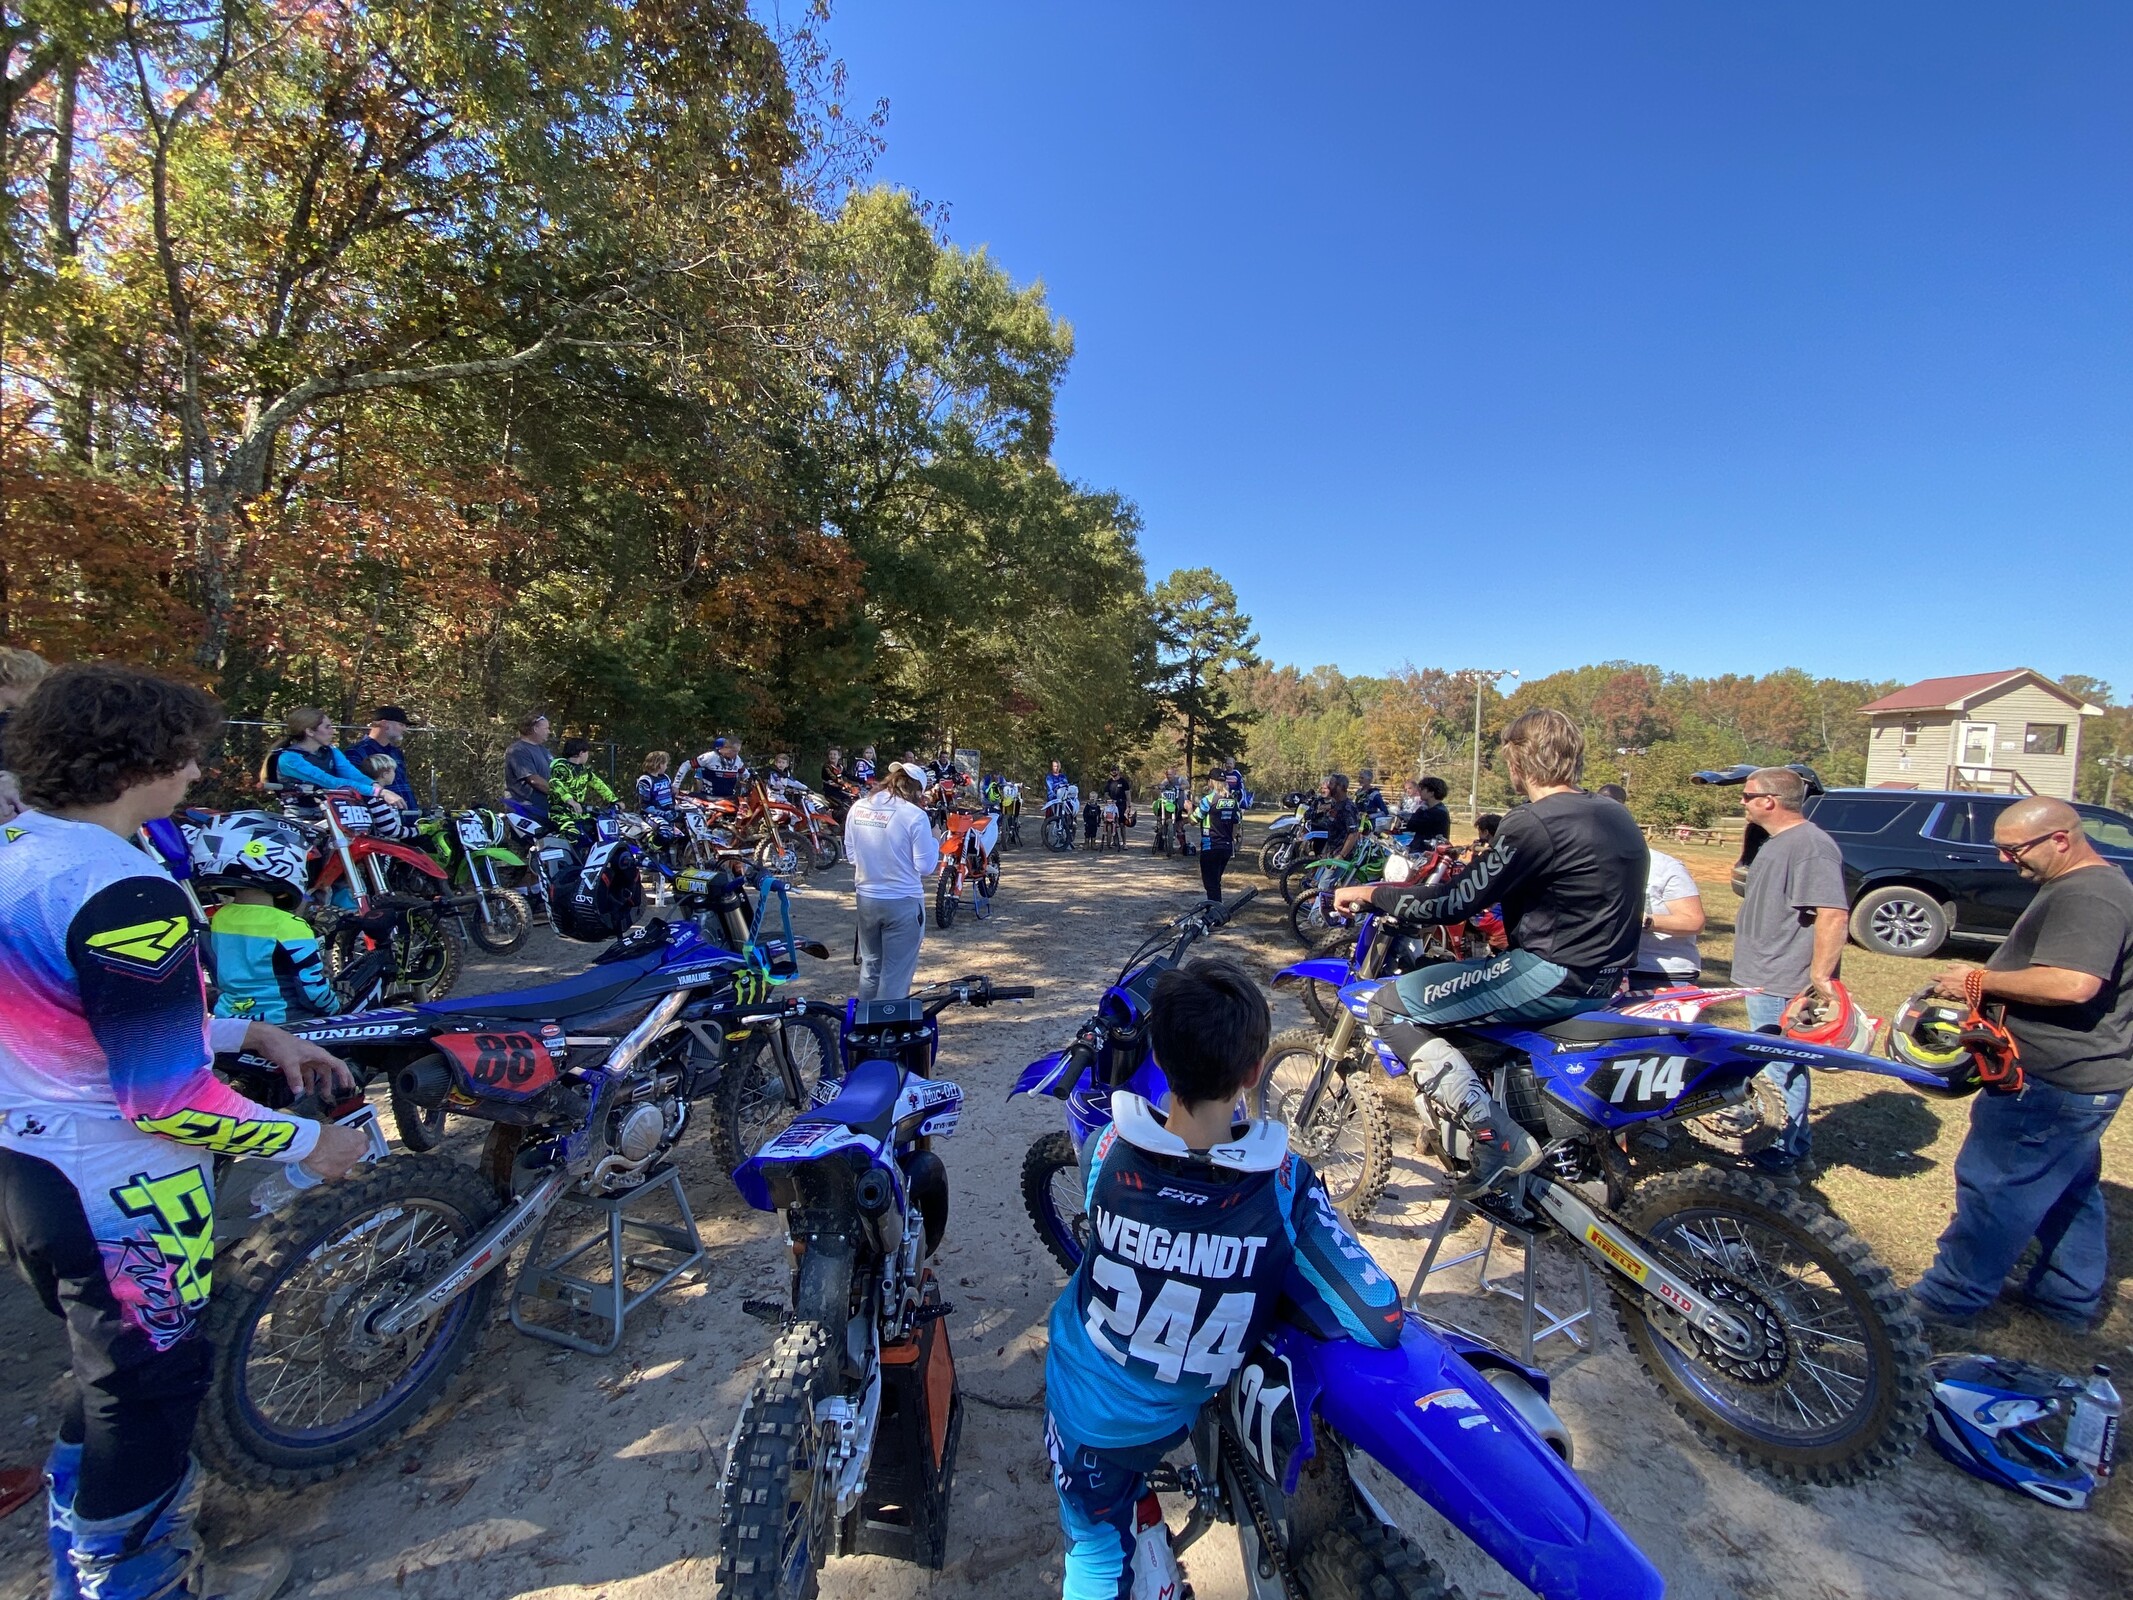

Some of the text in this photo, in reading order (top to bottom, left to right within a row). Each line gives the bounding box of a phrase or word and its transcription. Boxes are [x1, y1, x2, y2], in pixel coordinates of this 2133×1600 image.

[250, 845, 262, 854] 5
[1393, 835, 1516, 919] FASTHOUSE
[677, 971, 711, 986] YAMALUBE
[1424, 958, 1512, 1005] FASTHOUSE
[473, 1034, 536, 1086] 88
[1745, 1043, 1825, 1061] DUNLOP
[924, 1084, 960, 1104] Muc-Off
[1609, 1056, 1690, 1104] 714
[1156, 1187, 1209, 1206] FXR
[1096, 1205, 1268, 1279] WEIGANDT
[1590, 1230, 1642, 1276] PIRELLI
[1085, 1255, 1256, 1390] 244
